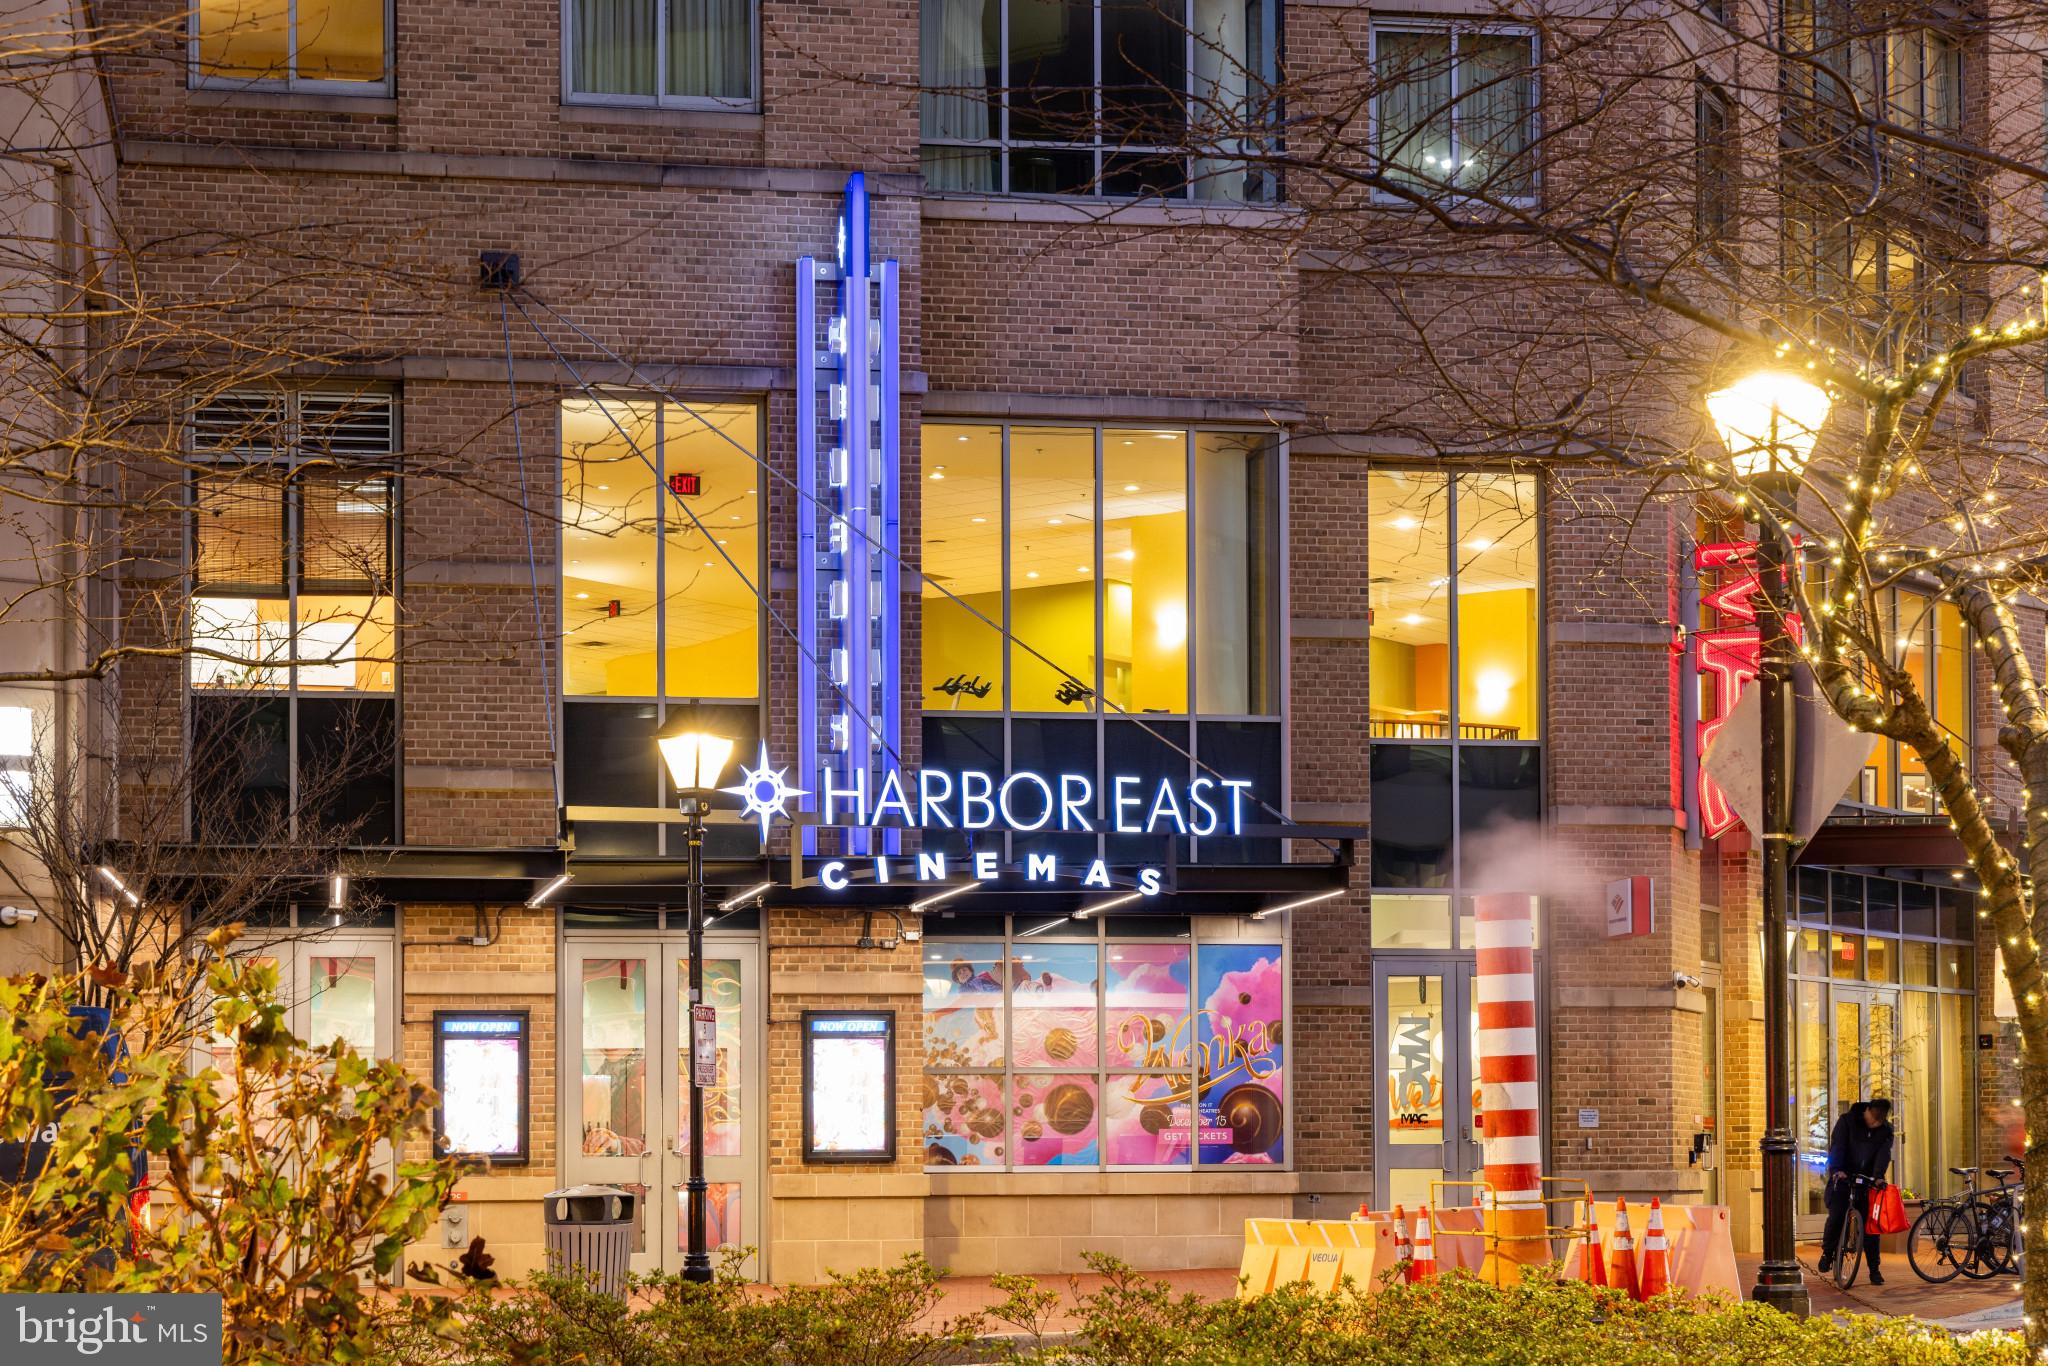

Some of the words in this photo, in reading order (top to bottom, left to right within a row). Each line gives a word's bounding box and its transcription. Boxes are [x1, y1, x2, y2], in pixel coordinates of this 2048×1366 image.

[675, 477, 697, 493] EXIT
[821, 767, 1093, 832] HARBOR
[1114, 776, 1252, 836] EAST
[818, 852, 1161, 896] CINEMAS
[695, 1008, 715, 1021] PARKING
[451, 1021, 480, 1032] NOW
[480, 1021, 512, 1032] OPEN
[819, 1021, 846, 1032] NOW
[847, 1021, 878, 1032] OPEN
[1118, 1009, 1276, 1100] Wonka
[1398, 1017, 1430, 1107] MAC
[1215, 1115, 1227, 1127] 15
[1400, 1113, 1429, 1125] MAC
[1164, 1132, 1183, 1141] GET
[1187, 1131, 1228, 1141] TCKETS
[1311, 1252, 1338, 1263] VEOLIA
